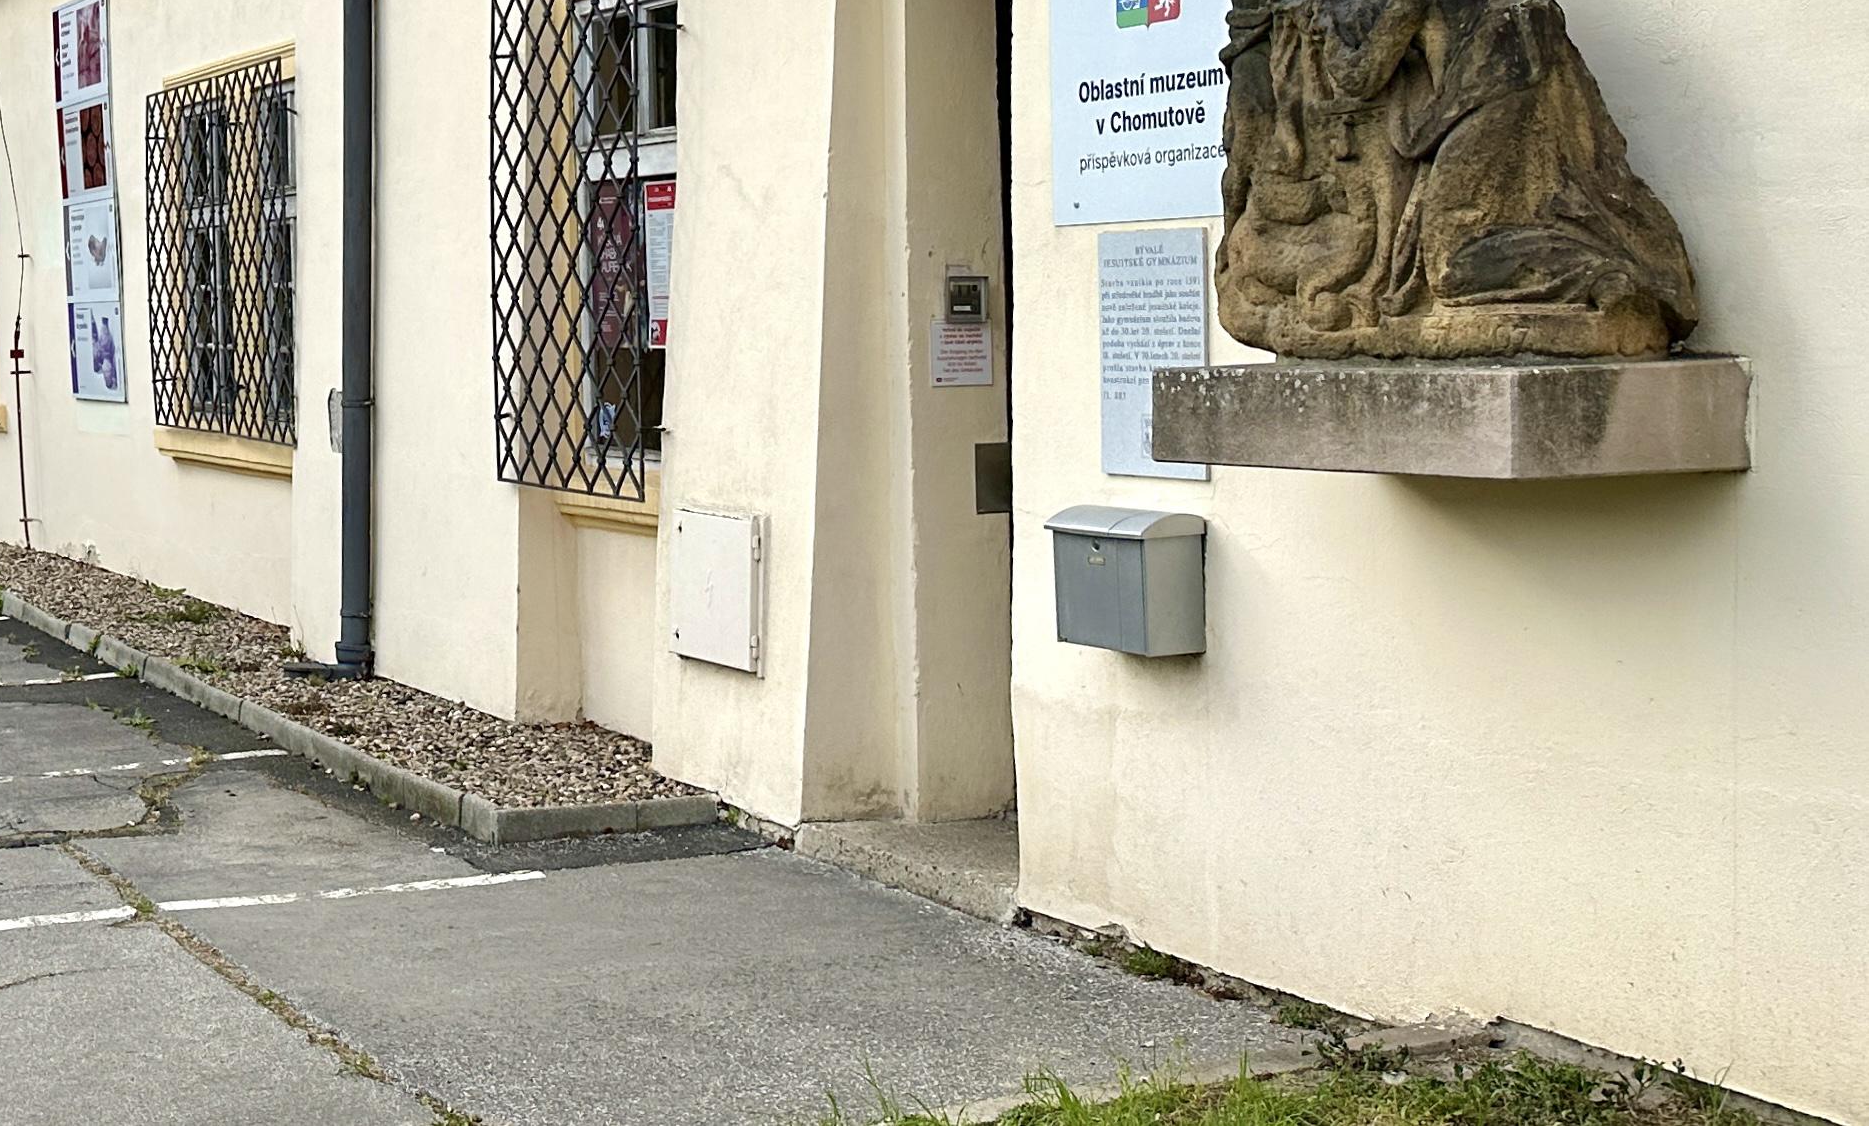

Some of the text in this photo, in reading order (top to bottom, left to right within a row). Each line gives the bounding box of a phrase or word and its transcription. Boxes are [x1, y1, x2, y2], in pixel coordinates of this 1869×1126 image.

[1078, 65, 1224, 103] Oblastní muzeum
[1096, 100, 1205, 135] v Chomutově
[1079, 143, 1225, 174] příspěvková organizace
[1135, 243, 1164, 255] BÝVALÉ
